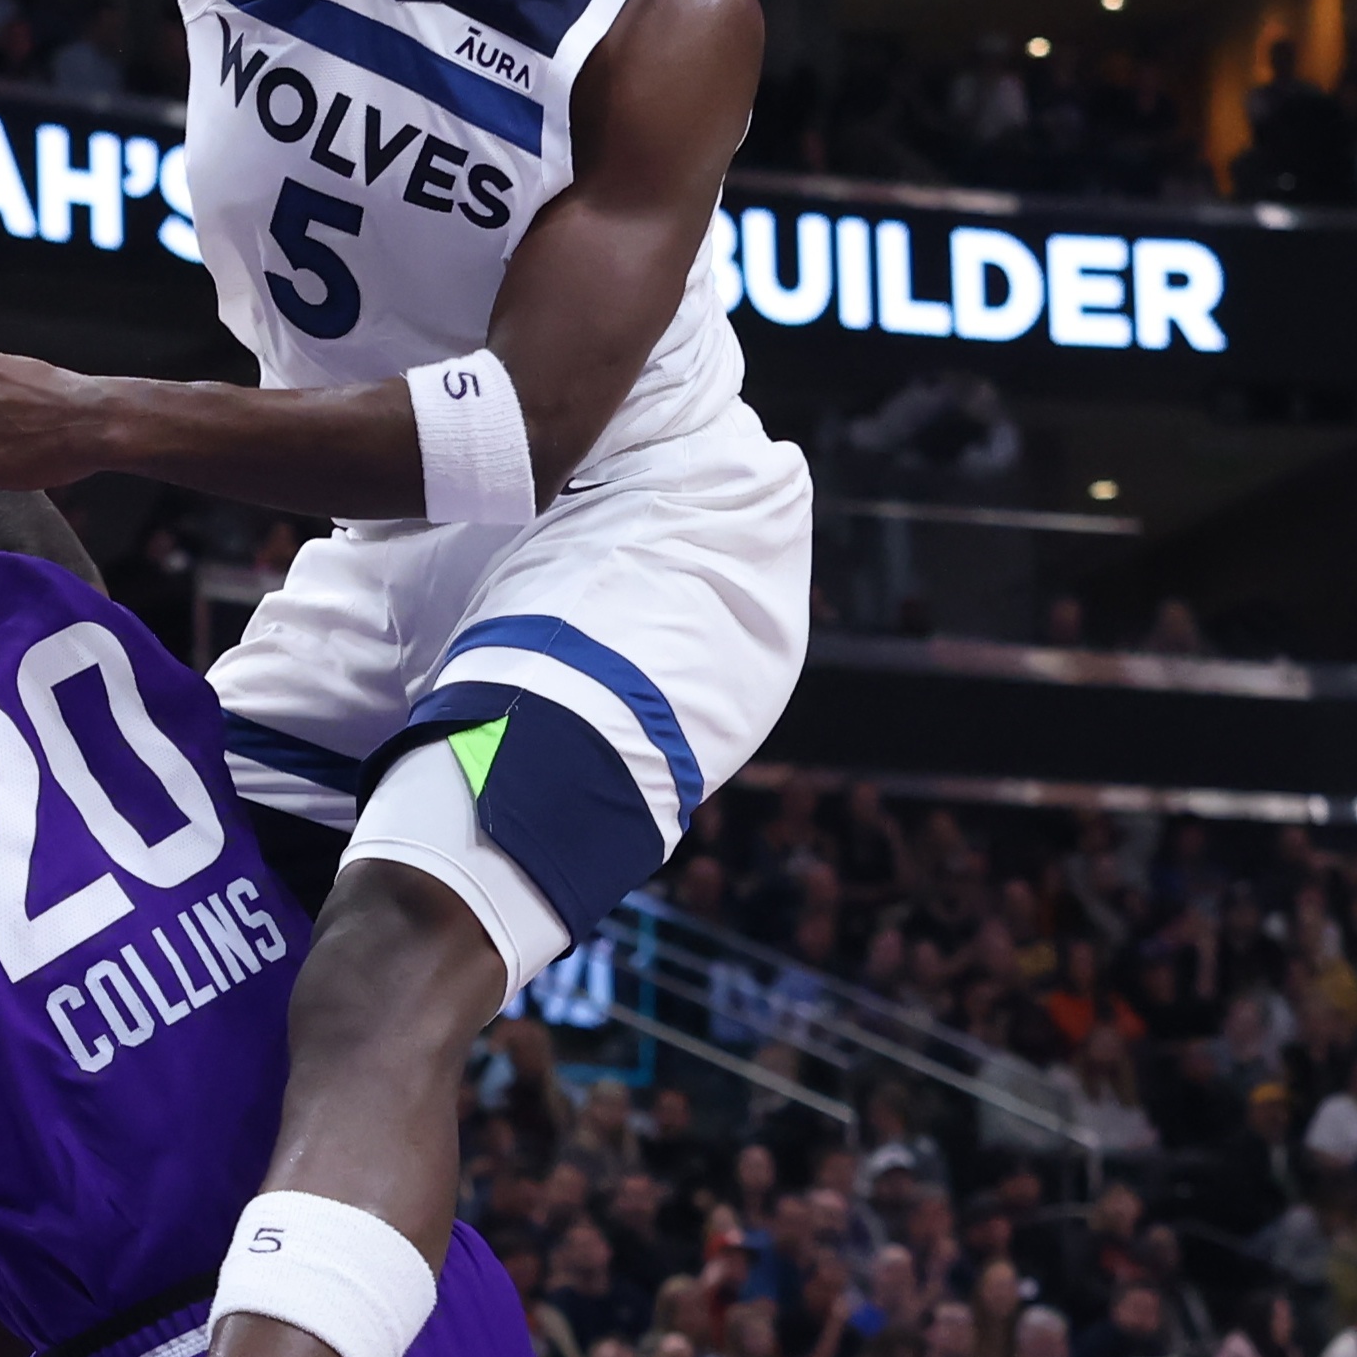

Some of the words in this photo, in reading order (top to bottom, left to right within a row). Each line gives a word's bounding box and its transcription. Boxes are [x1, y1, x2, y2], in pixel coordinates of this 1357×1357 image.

[215, 11, 515, 231] WOLVES
[264, 176, 365, 340] 5
[443, 370, 480, 400] 5
[46, 876, 287, 1074] COLLINS
[247, 1227, 285, 1254] 5
